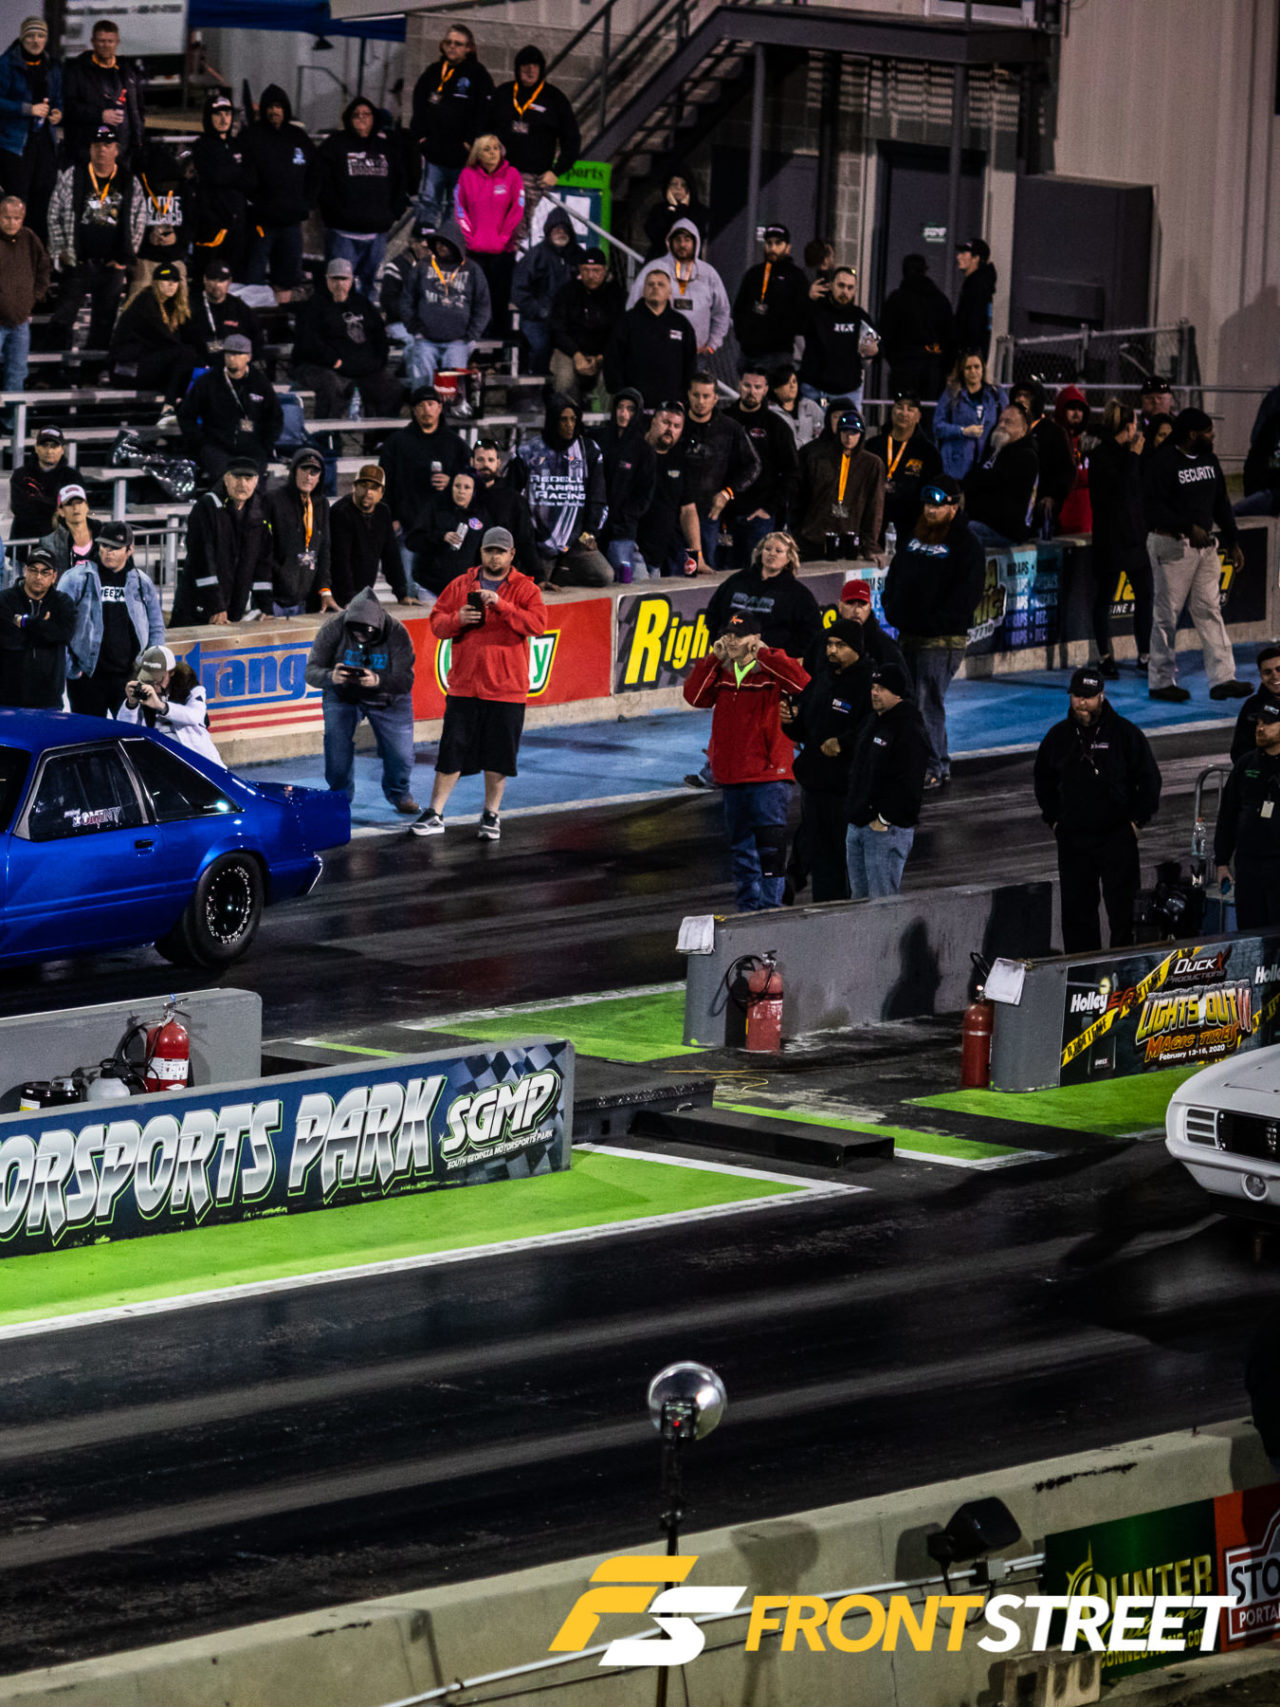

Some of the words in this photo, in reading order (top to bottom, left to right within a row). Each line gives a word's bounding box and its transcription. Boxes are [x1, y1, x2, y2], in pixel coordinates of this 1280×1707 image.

[567, 168, 604, 181] ports
[1178, 465, 1216, 484] SECURITY
[536, 490, 587, 501] RACING
[625, 598, 713, 686] Righ
[180, 641, 307, 700] trang
[1070, 991, 1108, 1014] Holley
[1136, 988, 1200, 1046] LIGHTS
[1205, 985, 1238, 1028] OUT
[1145, 1033, 1196, 1063] MAGIC
[1199, 1022, 1240, 1048] TIRES
[1158, 1050, 1187, 1062] February
[1209, 1043, 1226, 1054] 2020
[443, 1072, 557, 1154] SGMP
[287, 1075, 448, 1204] PARK
[446, 1158, 468, 1170] SOUTH
[467, 1150, 494, 1165] GEORGIA
[535, 1128, 554, 1143] PARK
[1231, 1557, 1280, 1606] STO
[1239, 1604, 1280, 1629] PORTA
